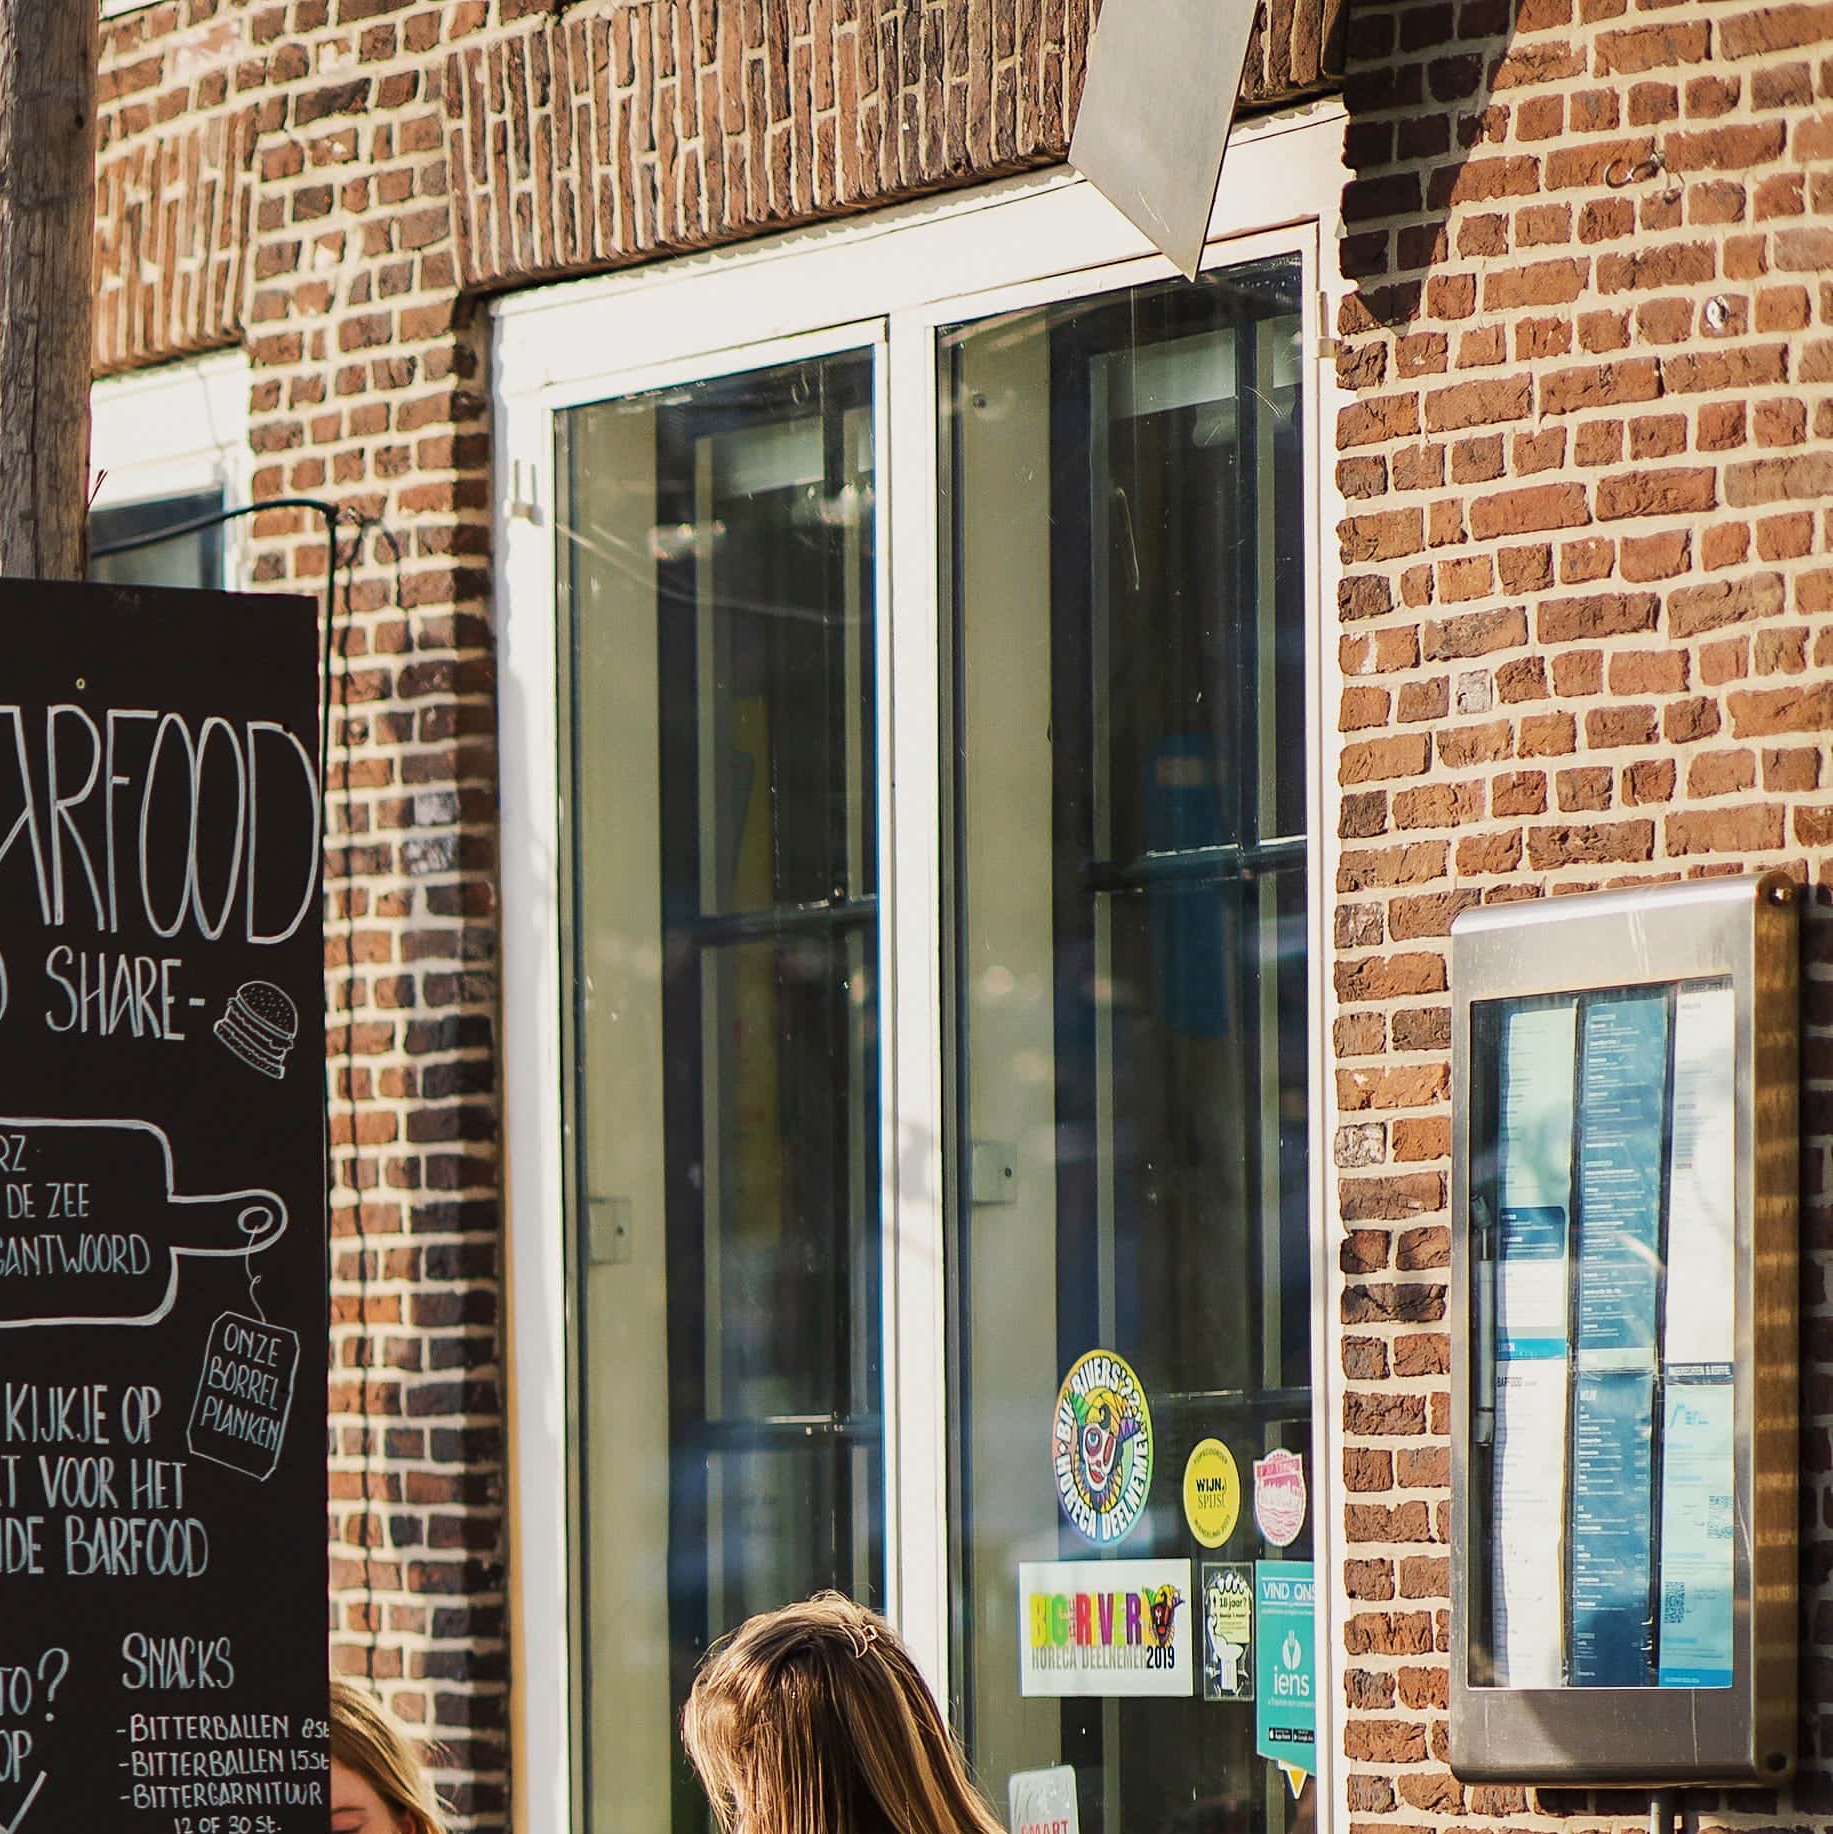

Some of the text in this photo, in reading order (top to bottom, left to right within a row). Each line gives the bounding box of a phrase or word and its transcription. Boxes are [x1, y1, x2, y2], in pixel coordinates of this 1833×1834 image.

[7, 1184, 35, 1218] DE
[46, 1183, 89, 1218] ZEE
[224, 1322, 282, 1367] ONZE
[208, 1356, 279, 1411] BORREL
[1070, 1356, 1121, 1398] RIVERS
[6, 1383, 109, 1444] KIJKJE
[122, 1386, 161, 1444] OP
[200, 1396, 281, 1451] PLANKEN
[39, 1456, 118, 1508] VOOR
[131, 1458, 187, 1509] HET
[1056, 1452, 1096, 1540] HORECA
[65, 1515, 208, 1578] BARFOOD
[1262, 1582, 1290, 1600] VIND
[1030, 1593, 1069, 1648] BIG
[122, 1633, 234, 1688] SNACKS
[1032, 1645, 1077, 1671] HORECA
[1146, 1646, 1175, 1670] 2019
[1274, 1665, 1310, 1697] iens
[174, 1817, 193, 1834] 12
[199, 1817, 220, 1834] OF
